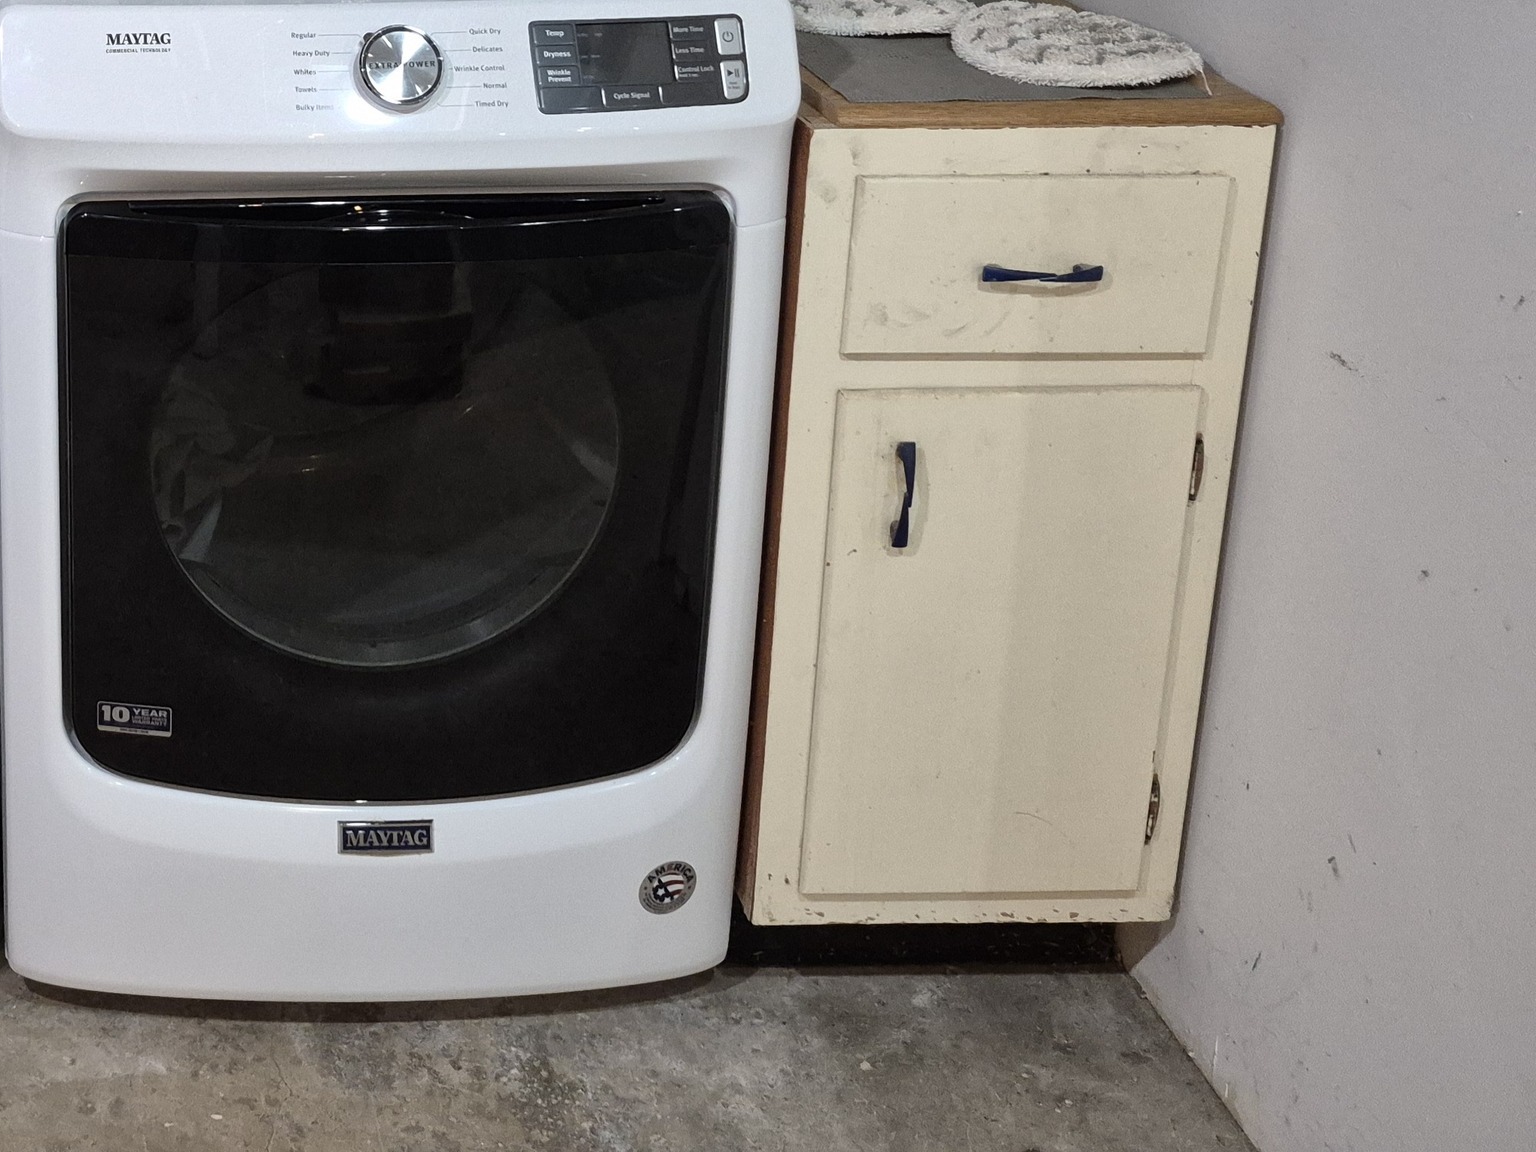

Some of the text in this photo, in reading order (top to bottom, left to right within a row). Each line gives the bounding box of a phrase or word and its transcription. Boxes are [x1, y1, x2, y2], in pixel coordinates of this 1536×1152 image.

[291, 32, 316, 40] Regular
[545, 30, 564, 38] Temp
[106, 33, 171, 45] MAYTAG
[292, 50, 330, 58] Heavy Duty
[544, 51, 571, 59] Dryness
[369, 61, 399, 69] EXTRA
[614, 91, 650, 100] Cycle Signal
[296, 104, 315, 112] Bulky
[497, 100, 509, 108] Dry
[101, 705, 168, 723] 10 YEAR
[345, 829, 429, 847] MAYTAG
[647, 863, 694, 884] AMERICA
